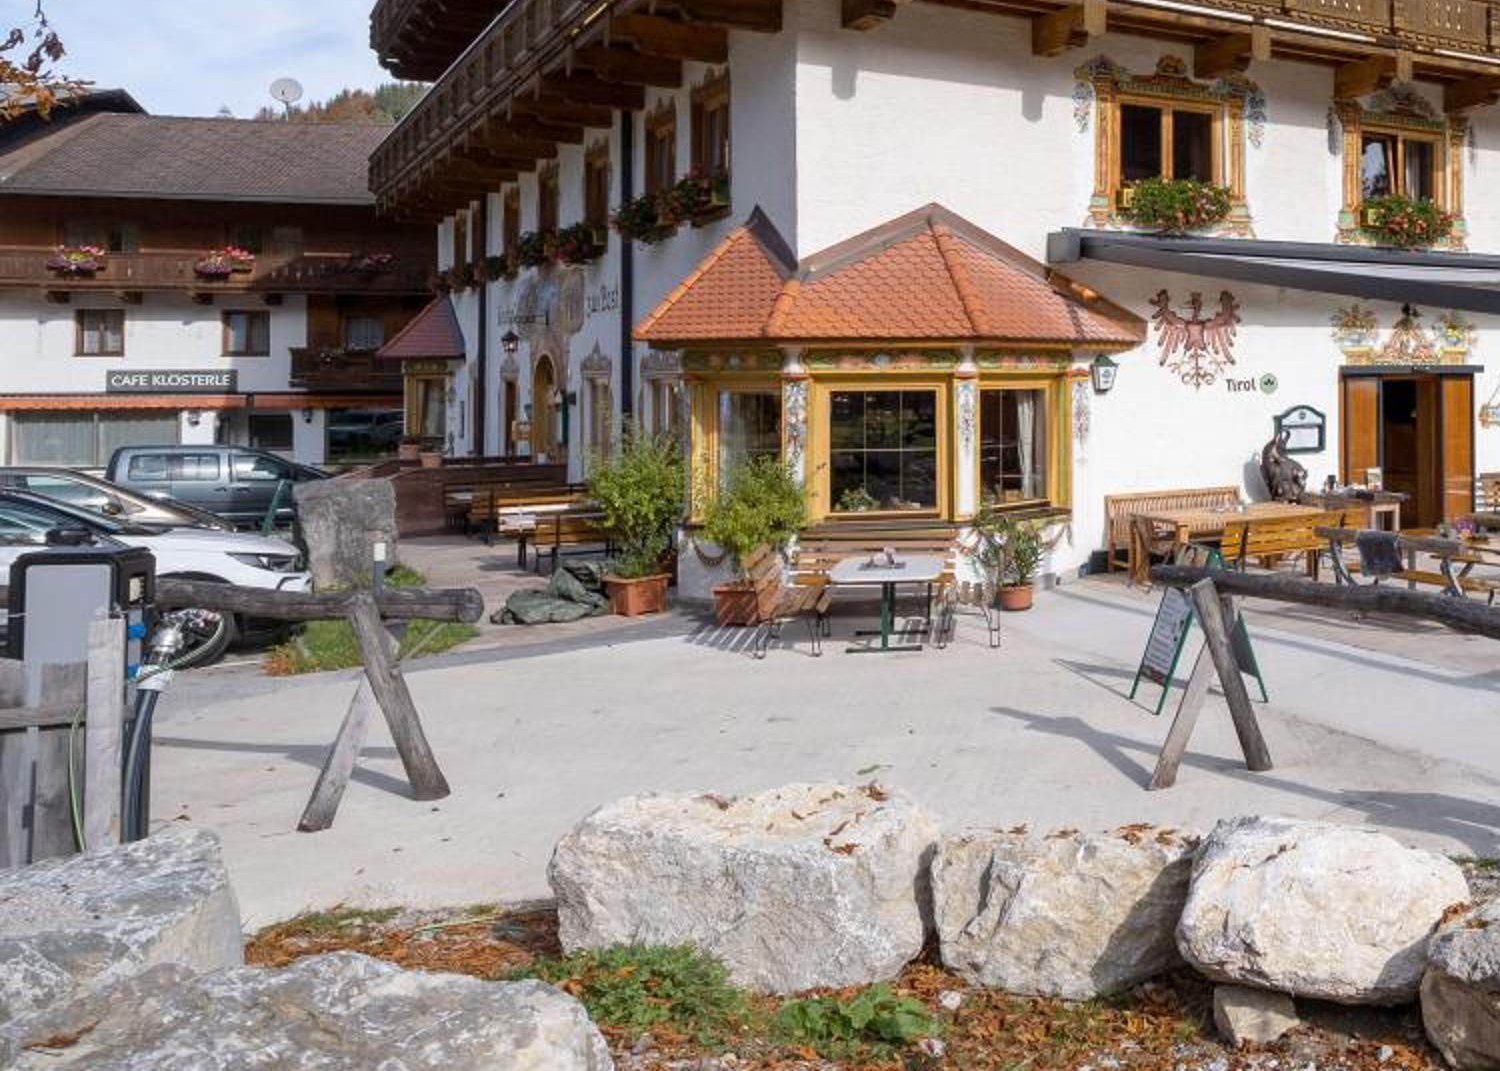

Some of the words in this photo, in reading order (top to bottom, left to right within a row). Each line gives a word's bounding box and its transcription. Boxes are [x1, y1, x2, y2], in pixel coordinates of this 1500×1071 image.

[111, 374, 148, 386] CAFE
[152, 374, 231, 386] KLOSTERLE
[1226, 377, 1257, 392] Tirol
